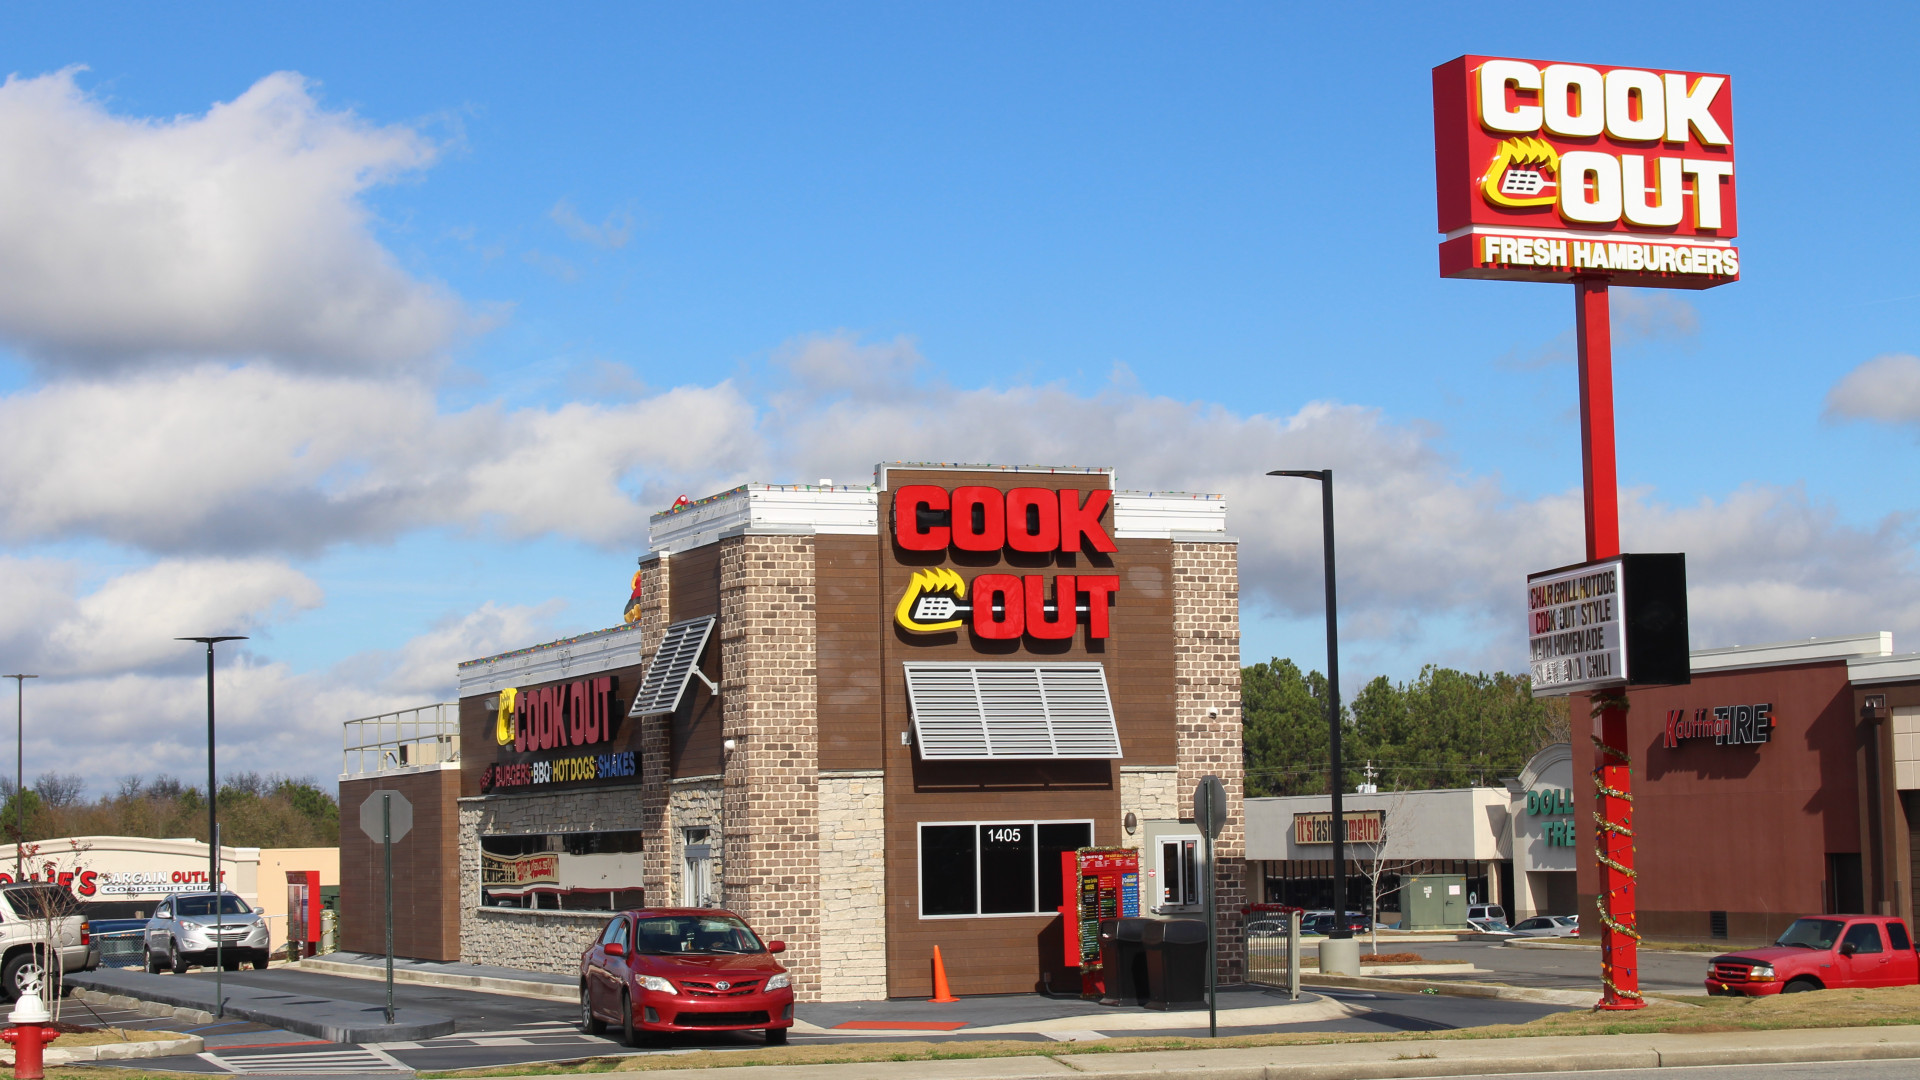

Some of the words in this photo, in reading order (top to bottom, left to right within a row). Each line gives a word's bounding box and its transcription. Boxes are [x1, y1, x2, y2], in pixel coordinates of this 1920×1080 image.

[1477, 59, 1732, 145] COOK
[1557, 150, 1734, 229] OUT
[1481, 236, 1568, 267] FRESH
[1570, 240, 1739, 276] HAMBURGERS
[895, 484, 1119, 553] COOK
[972, 573, 1121, 640] OUT
[1530, 583, 1553, 610] CHAR
[1554, 578, 1579, 604] GRILL
[1535, 607, 1557, 634] COOK
[1581, 598, 1612, 626] STYLE
[1554, 626, 1605, 656] HOMEMADE
[1584, 653, 1612, 680] CHILI
[514, 684, 568, 753] COOK
[570, 676, 612, 746] OUT
[1663, 708, 1731, 748] Kauffman
[1714, 703, 1769, 745] TIRE
[495, 762, 532, 788] BURGERS
[533, 760, 551, 784] BBQ
[552, 758, 570, 782] HOT
[570, 755, 596, 781] DOGS
[597, 751, 636, 779] SHAKES
[987, 828, 1021, 842] 1405
[171, 870, 226, 884] OUTLT
